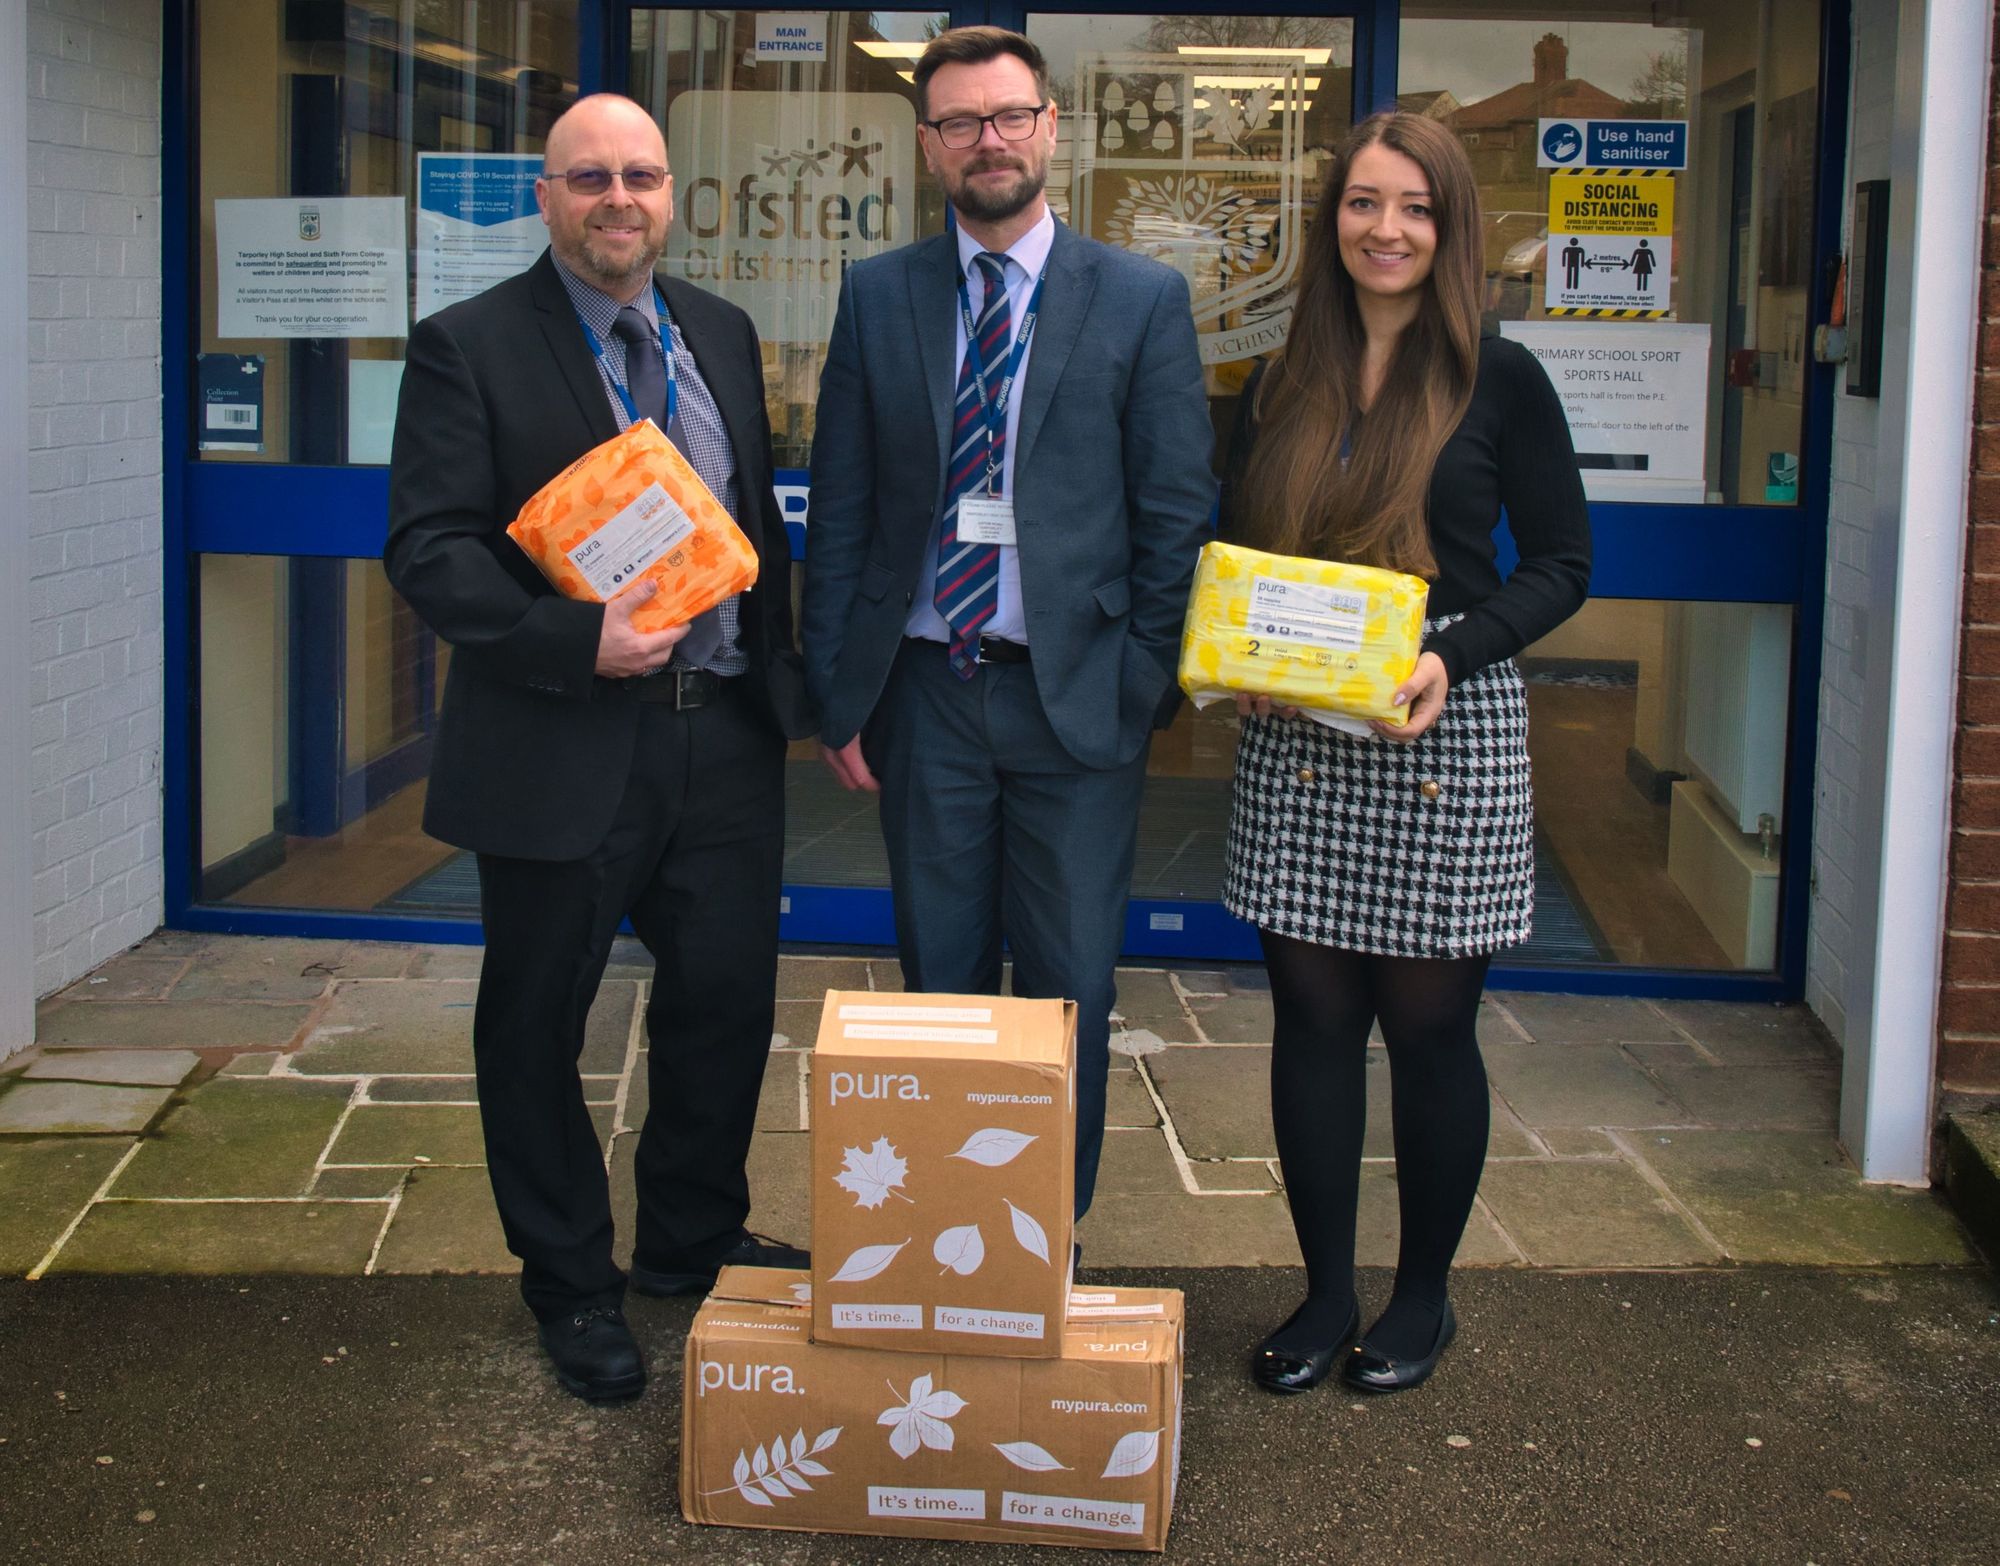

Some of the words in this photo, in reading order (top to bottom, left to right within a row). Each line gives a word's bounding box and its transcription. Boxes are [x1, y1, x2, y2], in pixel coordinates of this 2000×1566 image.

[776, 28, 807, 37] MAIN
[758, 41, 823, 51] ENTRANCE
[1598, 128, 1628, 142] Use
[1636, 129, 1674, 143] hand
[1601, 147, 1670, 160] sanitiser
[430, 171, 455, 180] Staying
[456, 171, 490, 179] COVID-19
[1583, 184, 1640, 200] SOCIAL
[683, 174, 893, 242] Ofsted
[1564, 202, 1658, 218] DISTANCING
[238, 251, 269, 259] Tarporley
[270, 251, 285, 259] High
[323, 250, 340, 258] Sixth
[360, 250, 385, 259] College
[285, 260, 327, 268] safeguarding
[342, 260, 376, 268] promoting
[684, 249, 860, 281] Outstandi
[255, 314, 277, 323] Thank
[279, 316, 292, 324] you
[293, 315, 303, 323] for
[305, 316, 321, 324] your
[1017, 312, 1036, 344] Tarporley
[1588, 349, 1638, 361] SCHOOL
[1641, 350, 1681, 363] SPORT
[1564, 369, 1610, 381] SPORTS
[1614, 370, 1644, 382] HALL
[206, 388, 239, 396] Collection
[1563, 392, 1588, 401] sports
[1590, 391, 1605, 400] hall
[1607, 392, 1614, 400] is
[1615, 392, 1635, 401] from
[1637, 393, 1651, 401] the
[1602, 421, 1620, 430] door
[1623, 422, 1632, 430] to
[1633, 422, 1647, 431] the
[1649, 422, 1663, 431] left
[1665, 423, 1673, 431] of
[1675, 423, 1689, 432] the
[1247, 639, 1260, 657] 2
[831, 1071, 931, 1106] pura.
[967, 1091, 1053, 1105] mypura.com
[707, 1319, 800, 1331] mypura.com
[839, 1310, 862, 1322] It's
[868, 1310, 914, 1323] time...
[940, 1311, 962, 1325] for
[967, 1317, 976, 1326] a
[980, 1316, 1039, 1333] change.
[699, 1360, 806, 1398] pura.
[1051, 1399, 1148, 1414] mypura.com
[877, 1494, 908, 1510] It's
[914, 1495, 975, 1512] time...
[1009, 1499, 1038, 1516] for
[1043, 1505, 1054, 1517] a
[1061, 1503, 1137, 1527] change.
